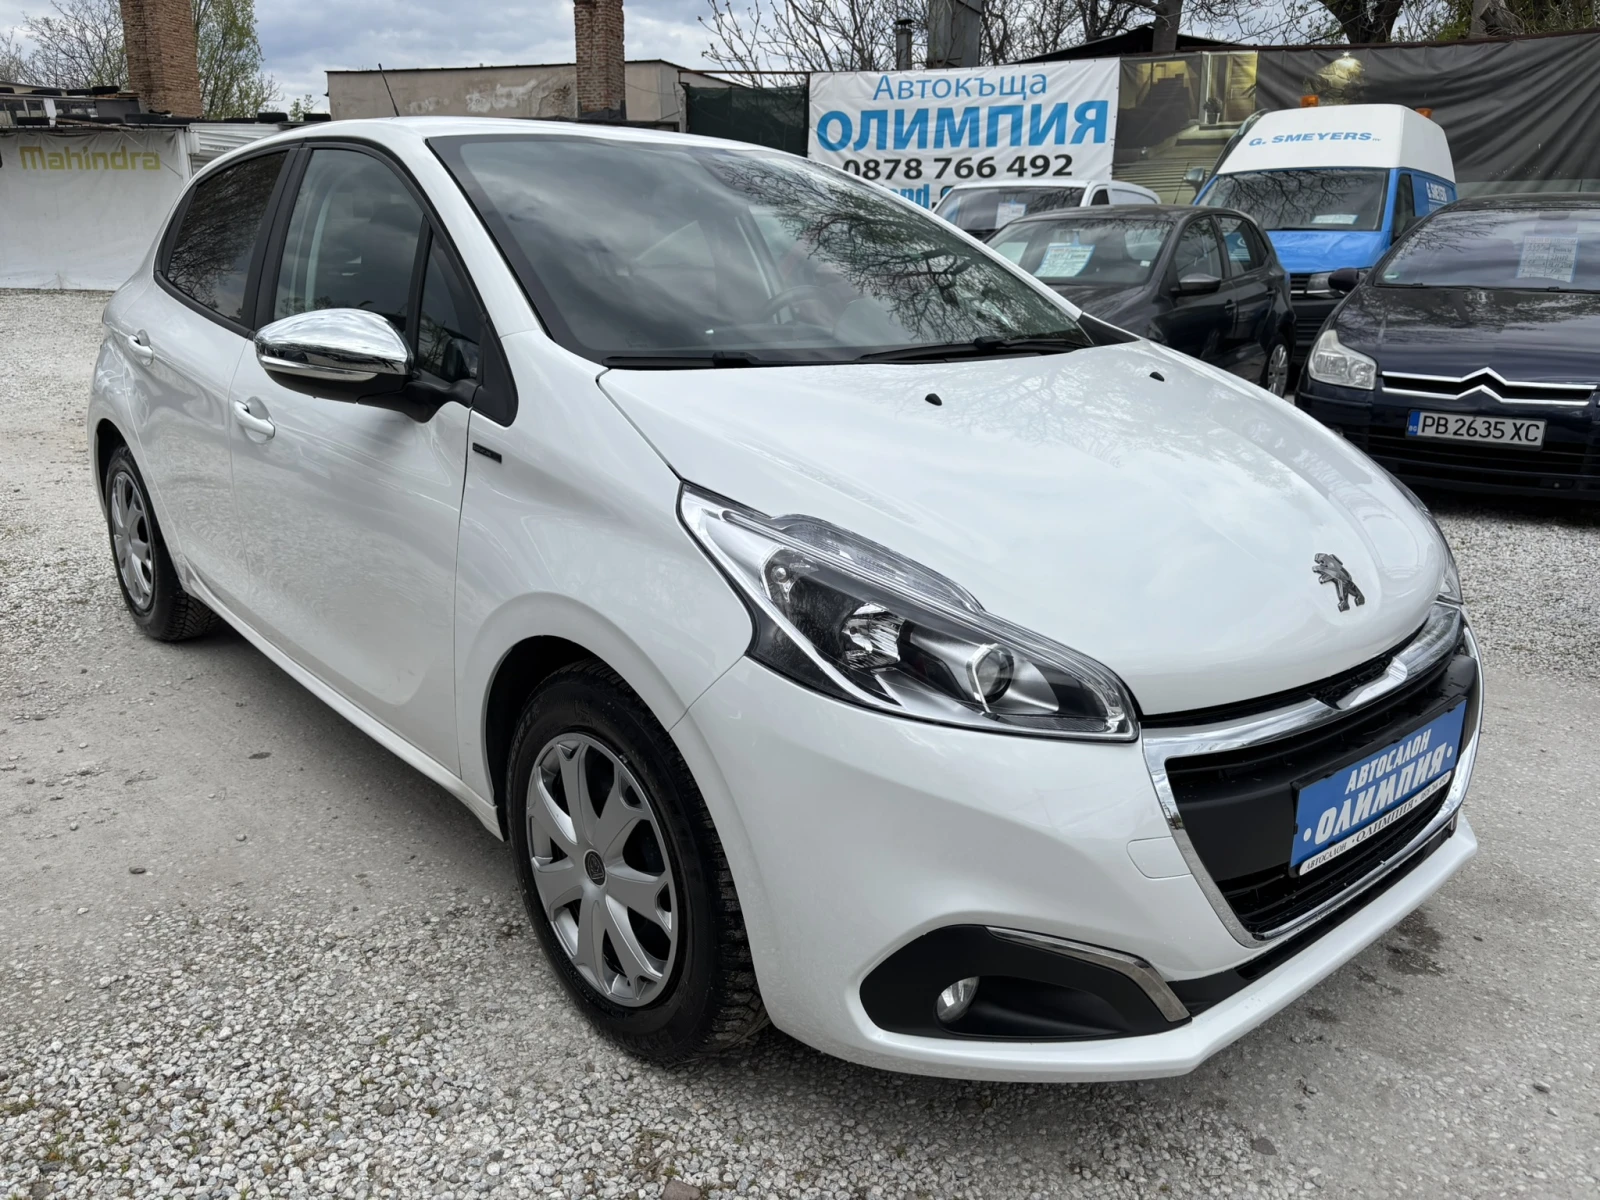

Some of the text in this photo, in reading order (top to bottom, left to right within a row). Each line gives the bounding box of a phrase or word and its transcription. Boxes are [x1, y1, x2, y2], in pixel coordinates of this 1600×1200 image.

[873, 73, 1047, 100] Автокъща
[816, 100, 1109, 152] ОЛИМПИЯ
[1272, 132, 1373, 144] SMEYERS
[19, 145, 161, 170] Mahindra
[843, 154, 1073, 181] 0878 766 492
[1452, 418, 1505, 439] 2635
[1344, 728, 1432, 795] АВТОСАЛОН
[1314, 742, 1448, 845] ОЛИМПИЯ
[1305, 841, 1348, 872] АВТОСАЛОН
[1356, 800, 1414, 842] ОЛИМПИЯ
